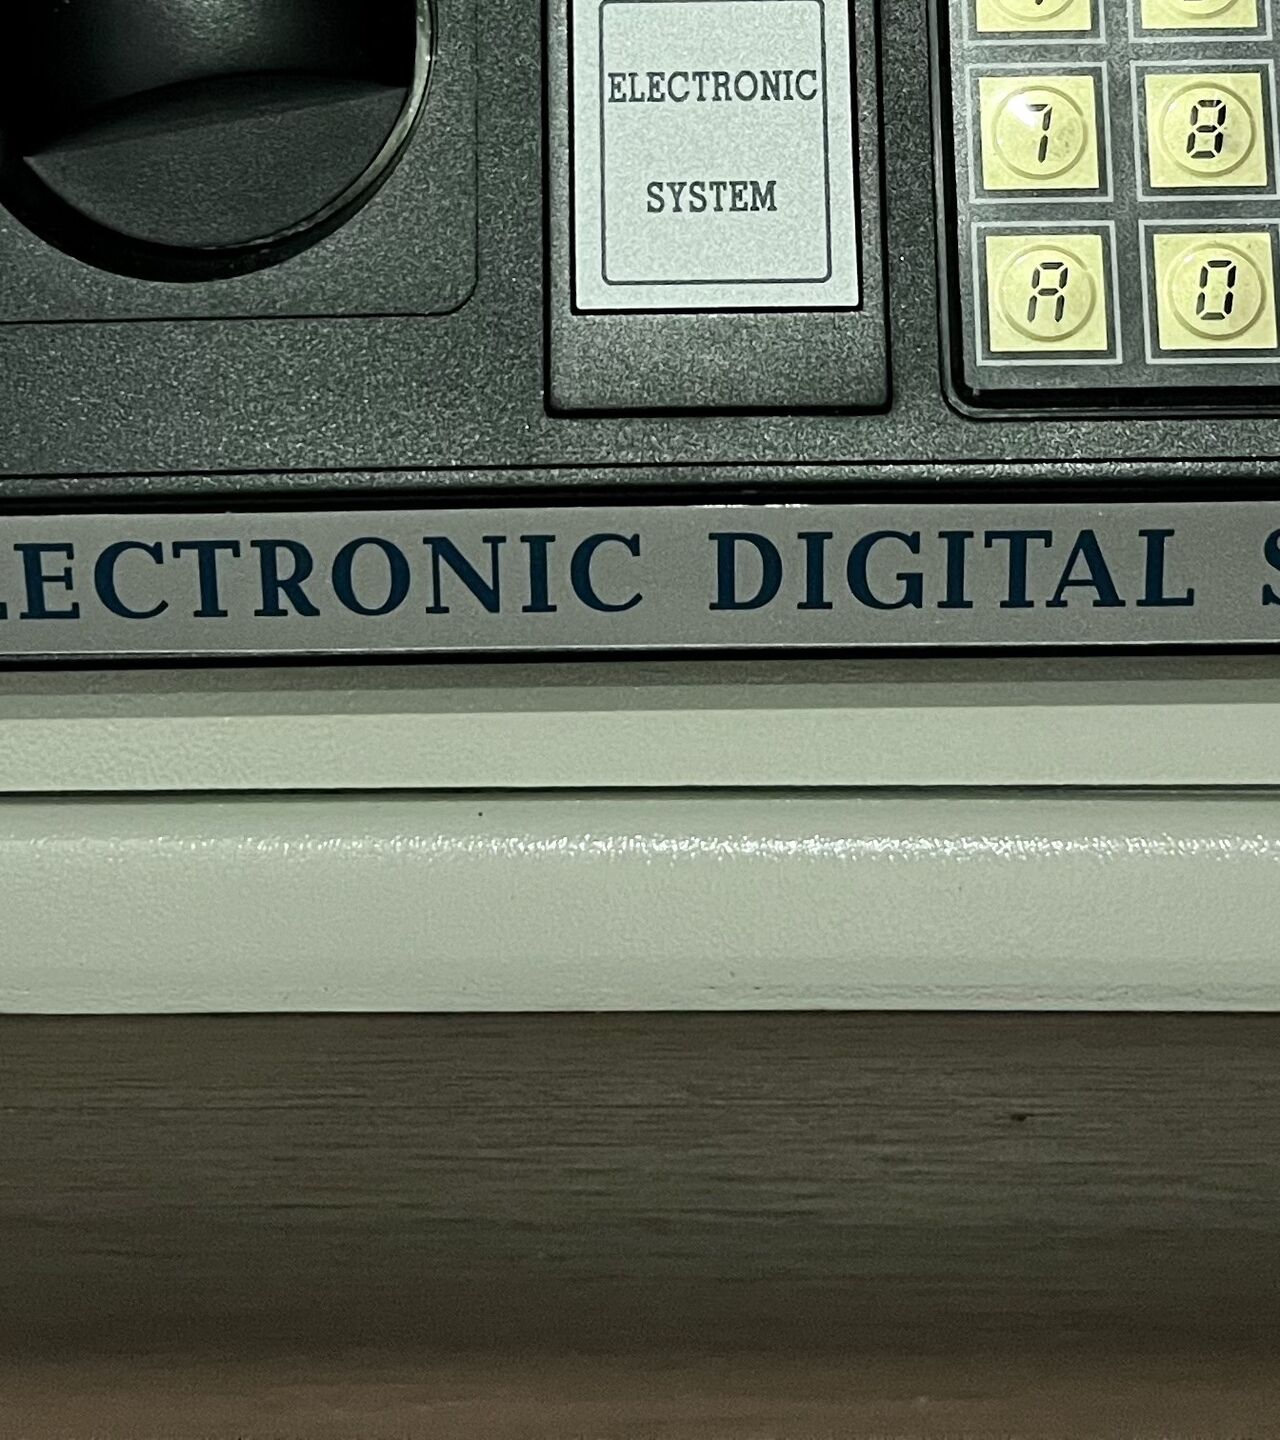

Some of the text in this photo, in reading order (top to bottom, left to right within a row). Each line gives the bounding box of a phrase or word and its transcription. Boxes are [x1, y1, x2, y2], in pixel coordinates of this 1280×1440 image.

[606, 69, 819, 104] ELECTRONIC
[1023, 102, 1053, 163] 7
[1186, 98, 1226, 159] 8
[645, 180, 778, 214] SYSTEM
[1026, 261, 1068, 323] A
[1196, 259, 1236, 320] 0
[708, 528, 1195, 611] DIGITAL
